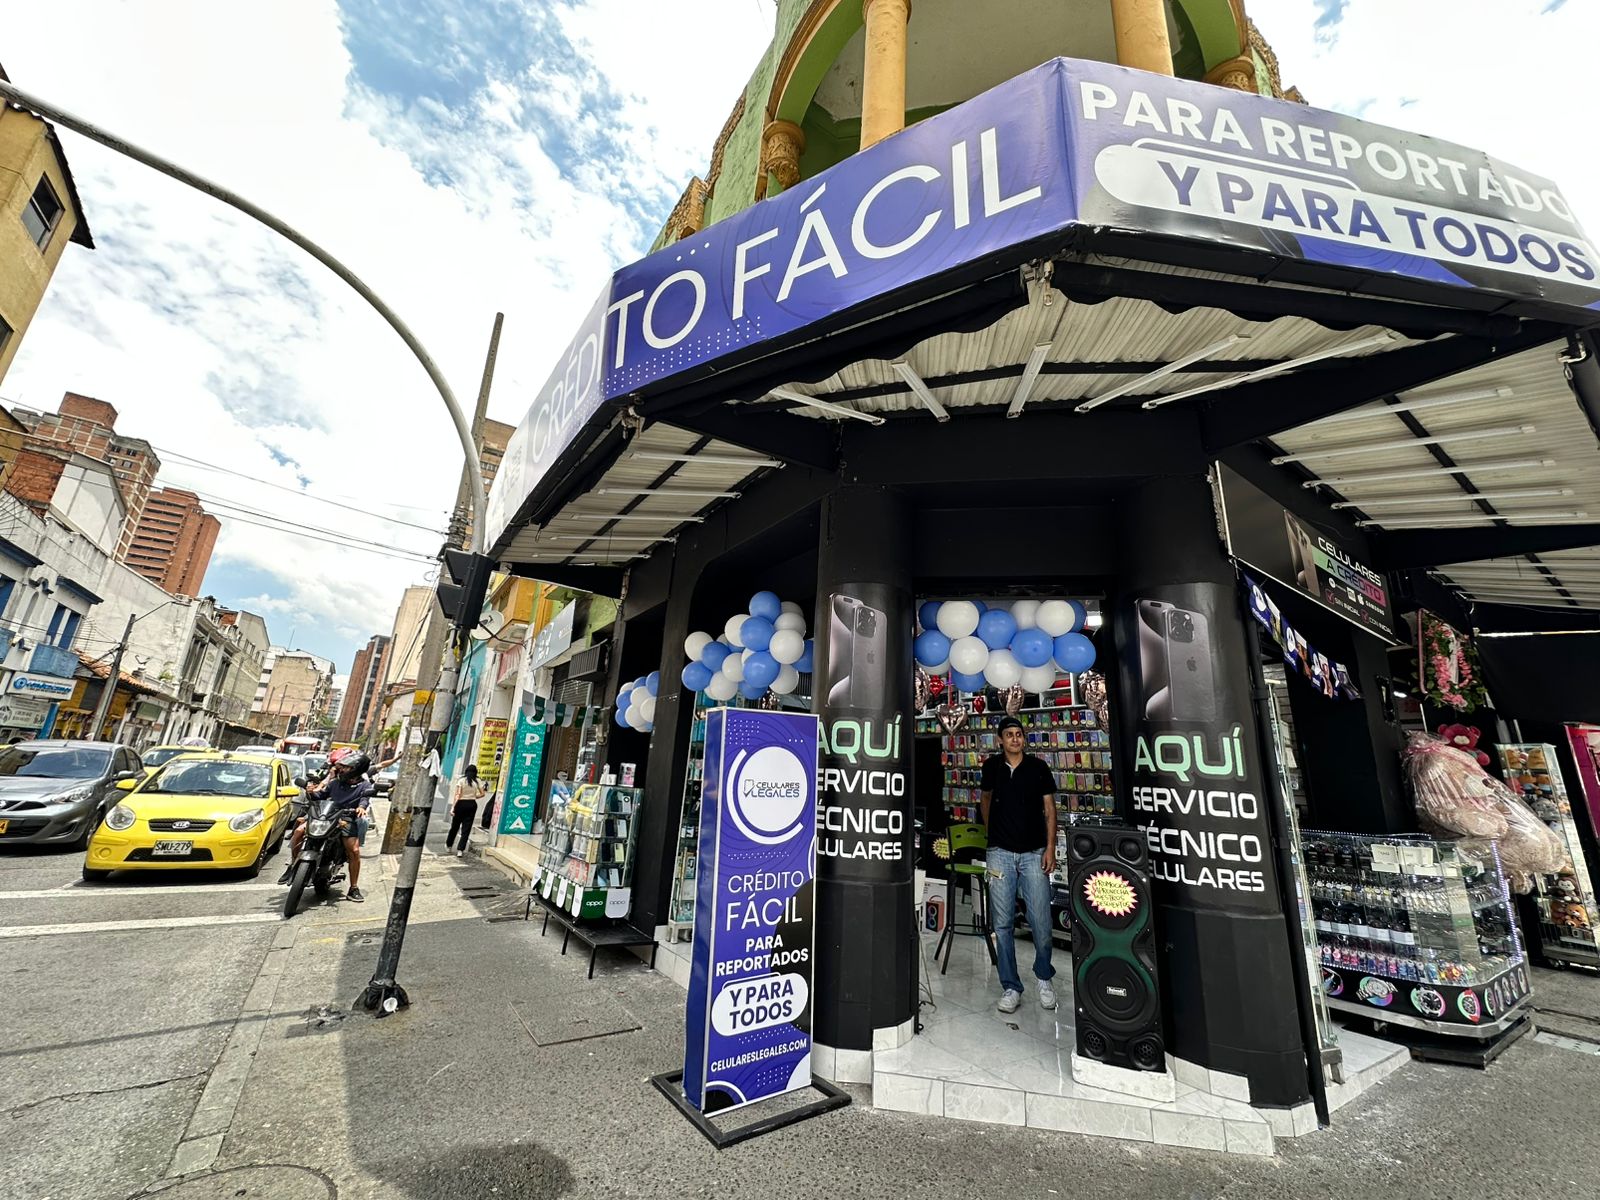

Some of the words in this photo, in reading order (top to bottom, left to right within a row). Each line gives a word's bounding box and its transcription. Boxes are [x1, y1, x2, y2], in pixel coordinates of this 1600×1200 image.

[1079, 81, 1253, 151] PARA
[1260, 116, 1575, 224] REPORTADO
[731, 127, 1042, 321] FÁCIL
[1156, 160, 1200, 206] Y
[1216, 171, 1392, 244] PARA
[1394, 206, 1597, 281] TODOS
[1317, 536, 1382, 587] CELULARES
[1326, 558, 1336, 573] A
[1134, 726, 1246, 782] AQUÍ
[751, 788, 800, 798] LEGALES
[816, 768, 905, 797] ERVICIO
[816, 798, 903, 834] ÉCNICO
[1132, 786, 1258, 820] SERVICIO
[728, 869, 804, 893] CRÉDITO
[726, 892, 803, 931] FÁCIL
[745, 934, 784, 953] PARA
[715, 947, 809, 977] REPORTADOS
[729, 988, 742, 1007] Y
[746, 979, 794, 1004] PARA
[729, 999, 793, 1030] TODOS
[710, 1037, 808, 1073] CELULARESLEGALES.COM
